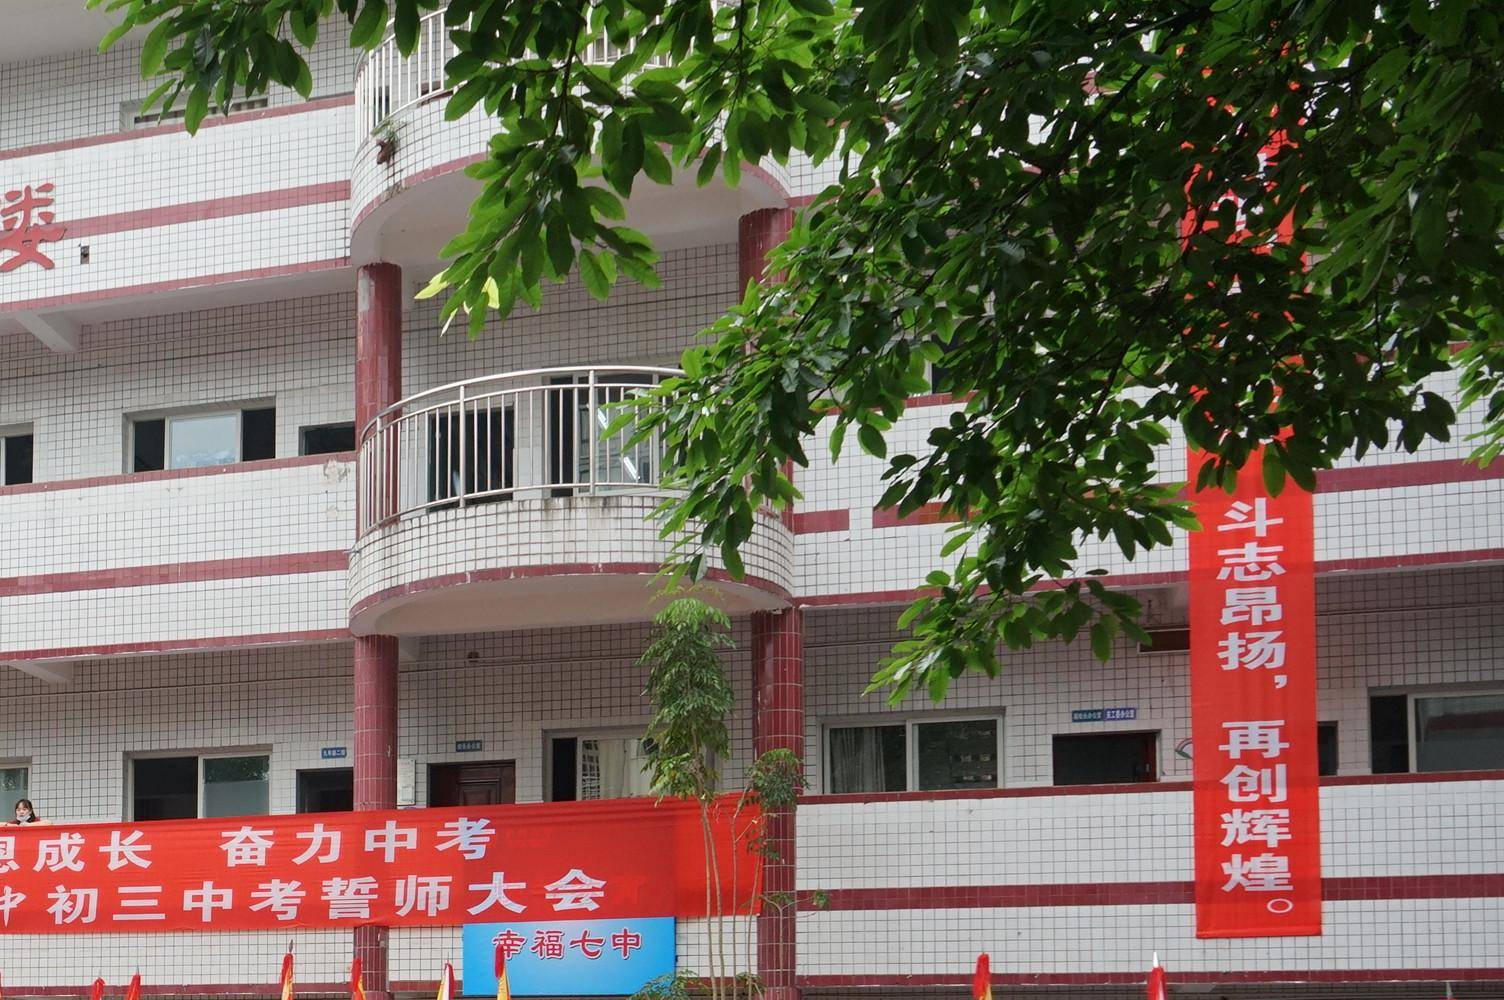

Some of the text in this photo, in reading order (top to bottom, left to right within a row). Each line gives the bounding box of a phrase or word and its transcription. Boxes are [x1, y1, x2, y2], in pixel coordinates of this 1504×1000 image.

[1216, 497, 1288, 689] 斗志昂扬，
[219, 817, 497, 867] 奋力中考
[1218, 720, 1294, 914] 再创辉煌。
[493, 927, 643, 960] 幸福七中
